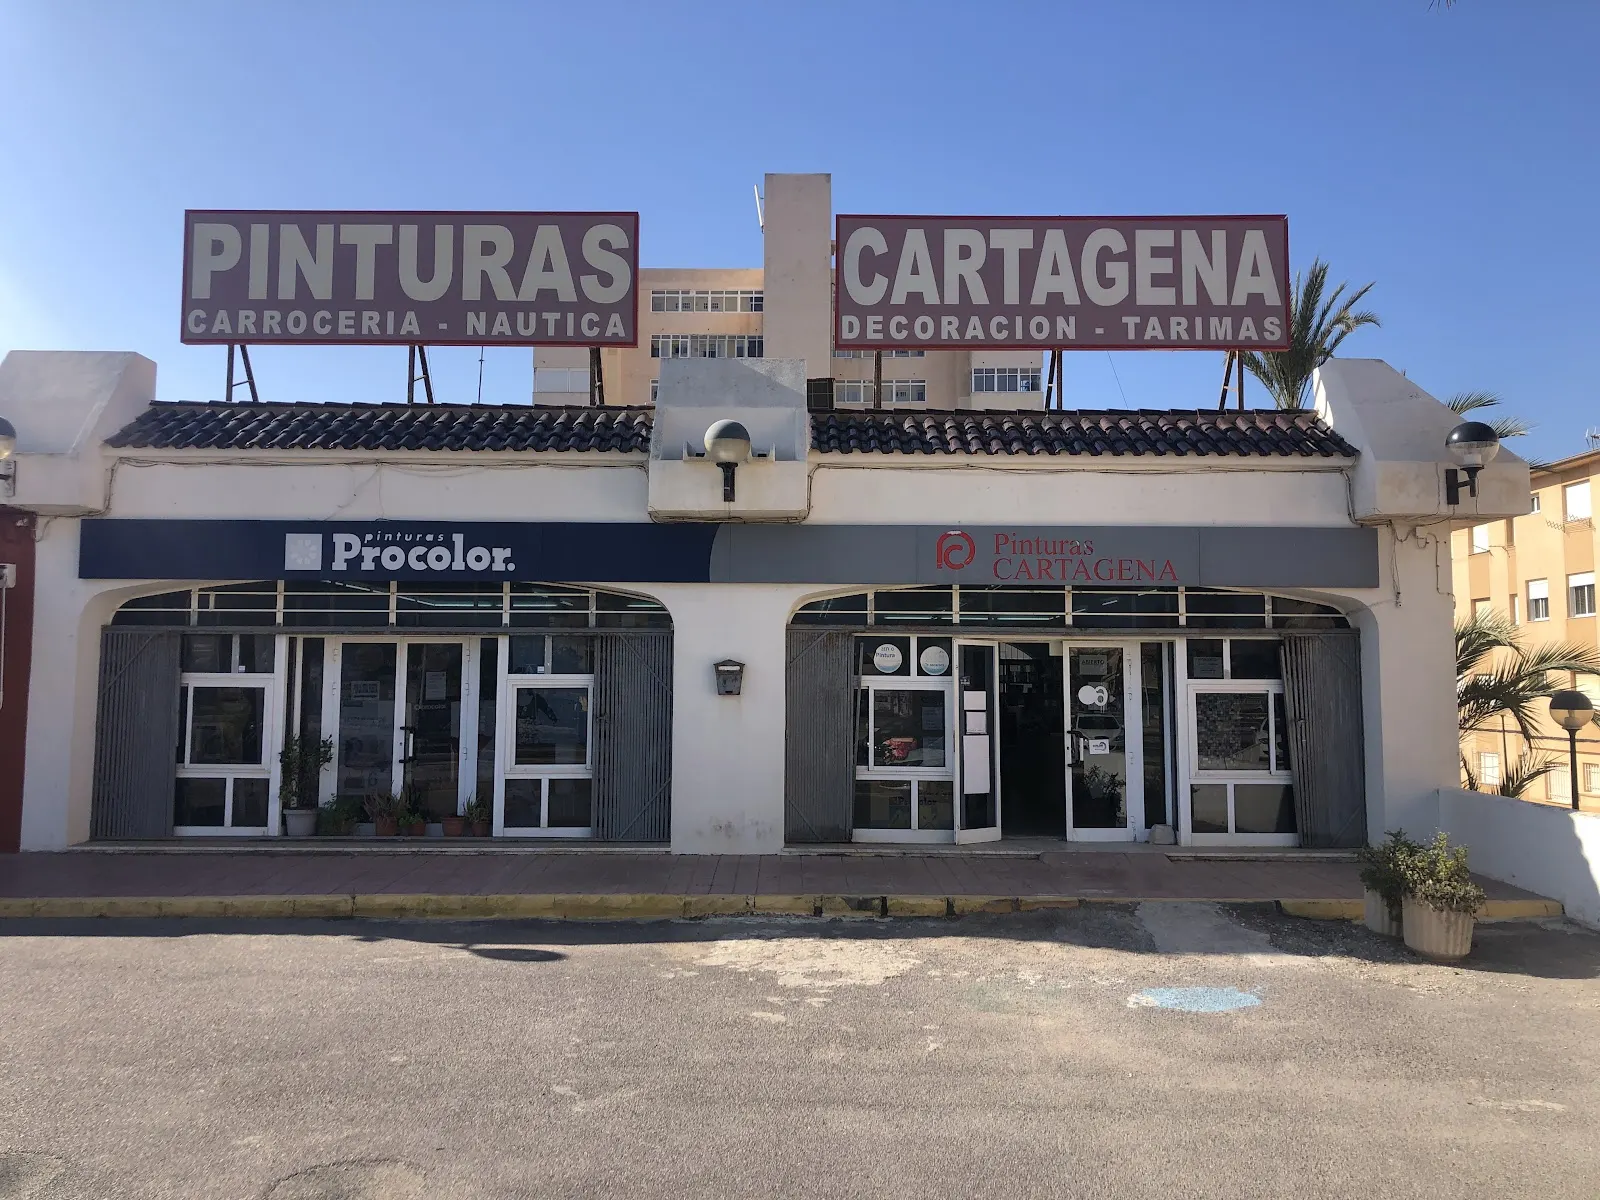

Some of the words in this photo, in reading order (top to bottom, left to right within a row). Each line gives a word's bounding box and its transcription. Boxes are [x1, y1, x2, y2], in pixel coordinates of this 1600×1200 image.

[191, 223, 632, 304] PINTURAS
[843, 226, 1282, 307] CARTAGENA
[187, 309, 421, 335] CARROCERIA
[466, 311, 626, 337] NAUTICA
[841, 315, 1076, 340] DECORACION
[1121, 316, 1282, 341] TARIMAS
[364, 530, 444, 543] pinturas
[994, 532, 1094, 556] Pinturas
[992, 558, 1179, 582] CARTAGENA
